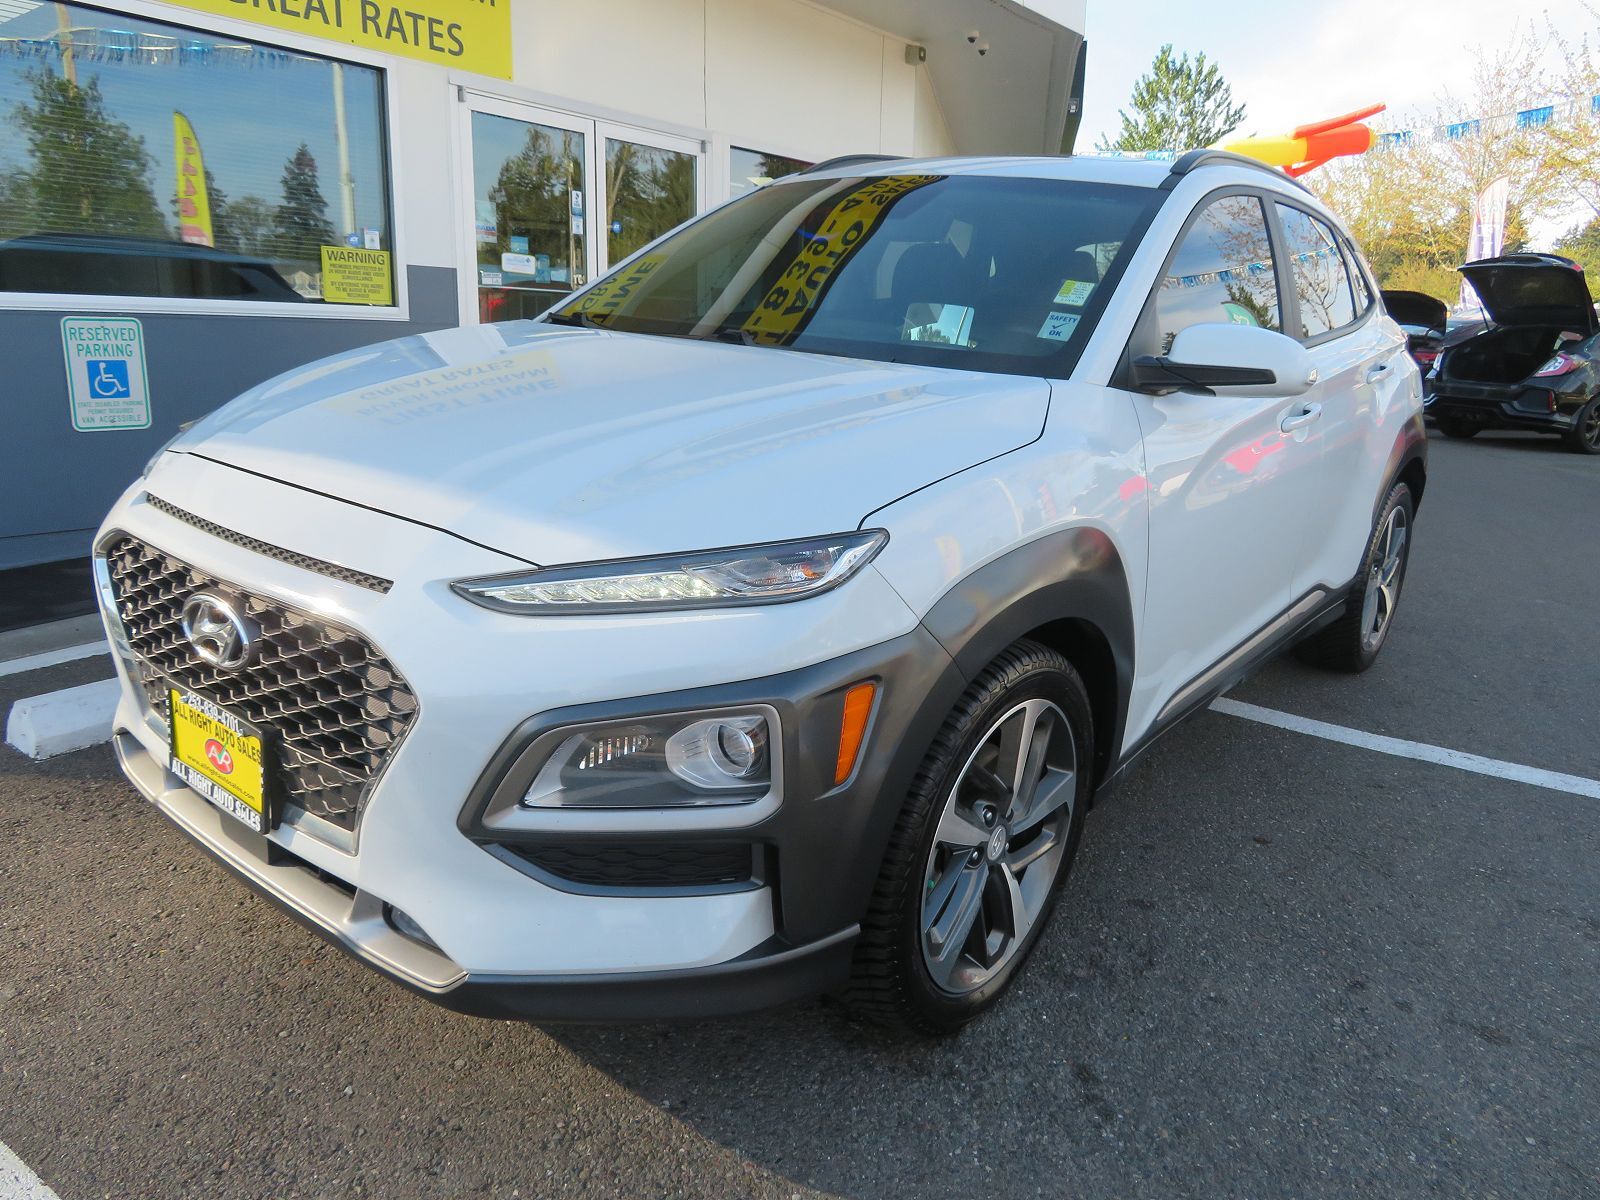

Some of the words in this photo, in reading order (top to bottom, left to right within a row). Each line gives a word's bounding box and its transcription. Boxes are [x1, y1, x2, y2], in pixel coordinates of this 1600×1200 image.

[360, 0, 464, 56] RATES
[326, 249, 385, 266] WARNING
[1050, 315, 1078, 323] SAFETY
[69, 327, 137, 342] RESERVED
[76, 343, 133, 357] PARKING
[82, 415, 96, 424] VAN
[99, 414, 142, 423] ACCESSIBLE
[174, 700, 188, 721] ALL
[189, 708, 213, 735] RIGHT
[214, 723, 236, 749] AUTO
[237, 736, 262, 765] SALES
[171, 759, 187, 779] ALL
[188, 771, 213, 797] RIGHT
[213, 784, 236, 811] AUTO
[235, 799, 261, 832] SALES
